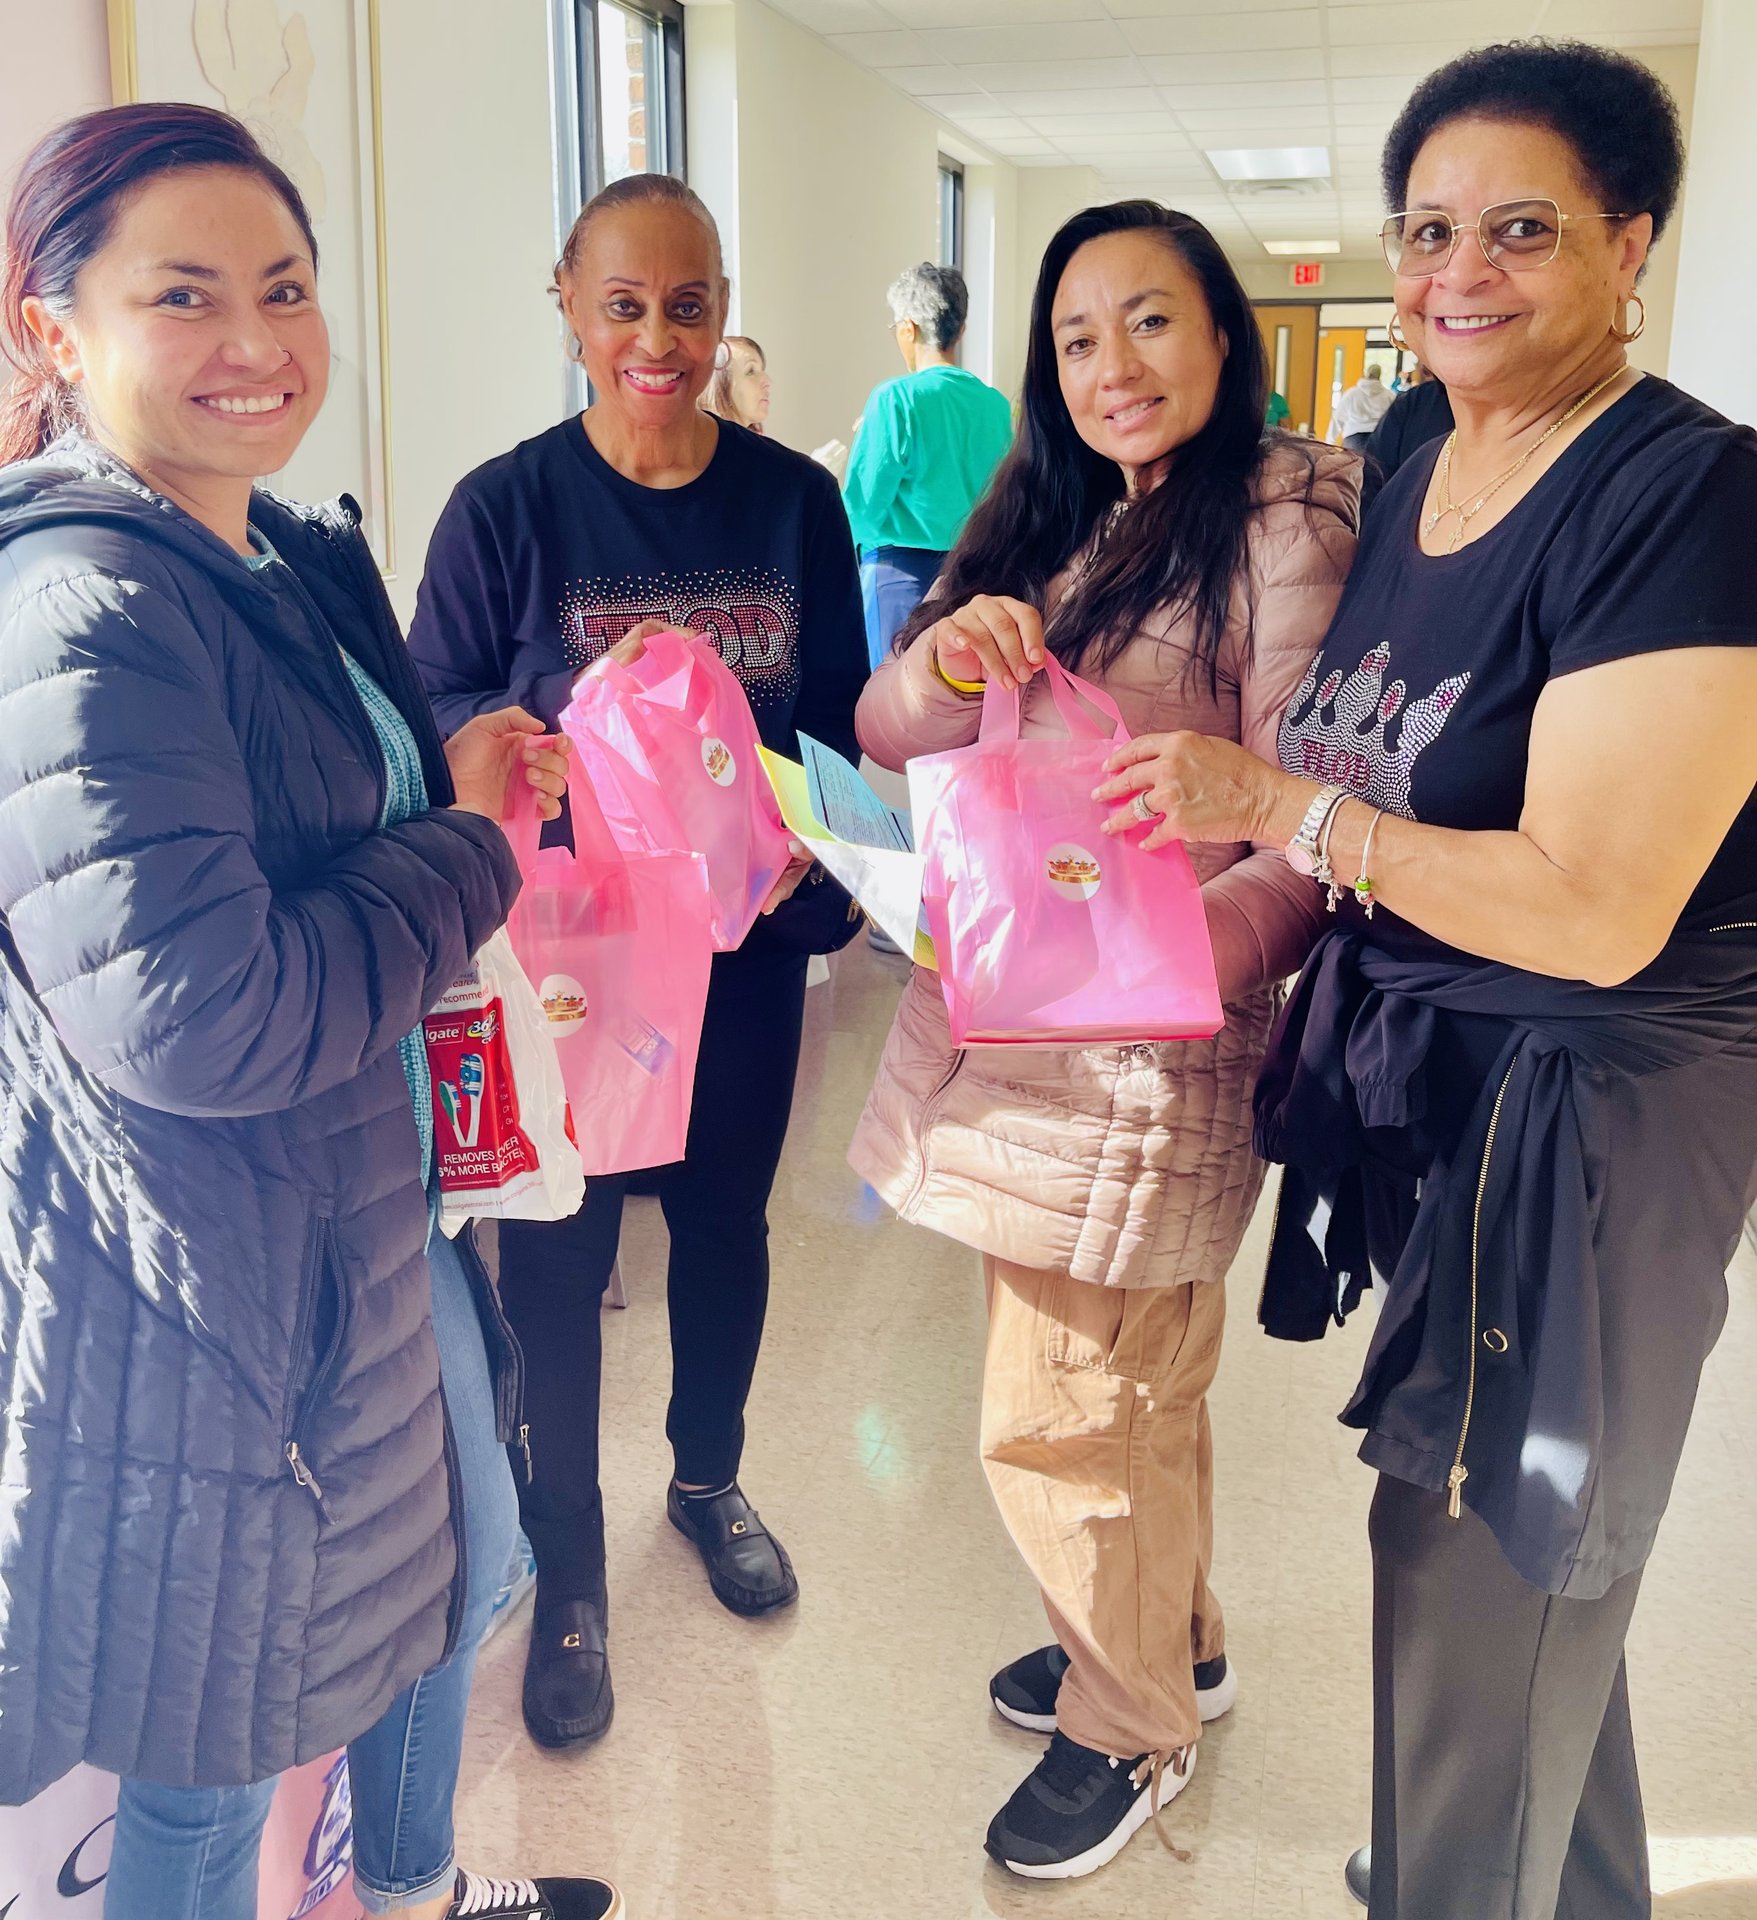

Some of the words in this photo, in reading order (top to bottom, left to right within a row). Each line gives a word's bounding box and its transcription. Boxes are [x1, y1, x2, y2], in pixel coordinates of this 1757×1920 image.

[1295, 263, 1320, 285] EXIT
[426, 1028, 459, 1042] lgate
[444, 1150, 495, 1164] REMOVES
[497, 1136, 519, 1158] OVER
[438, 1166, 456, 1177] 6%
[458, 1163, 490, 1175] MORE
